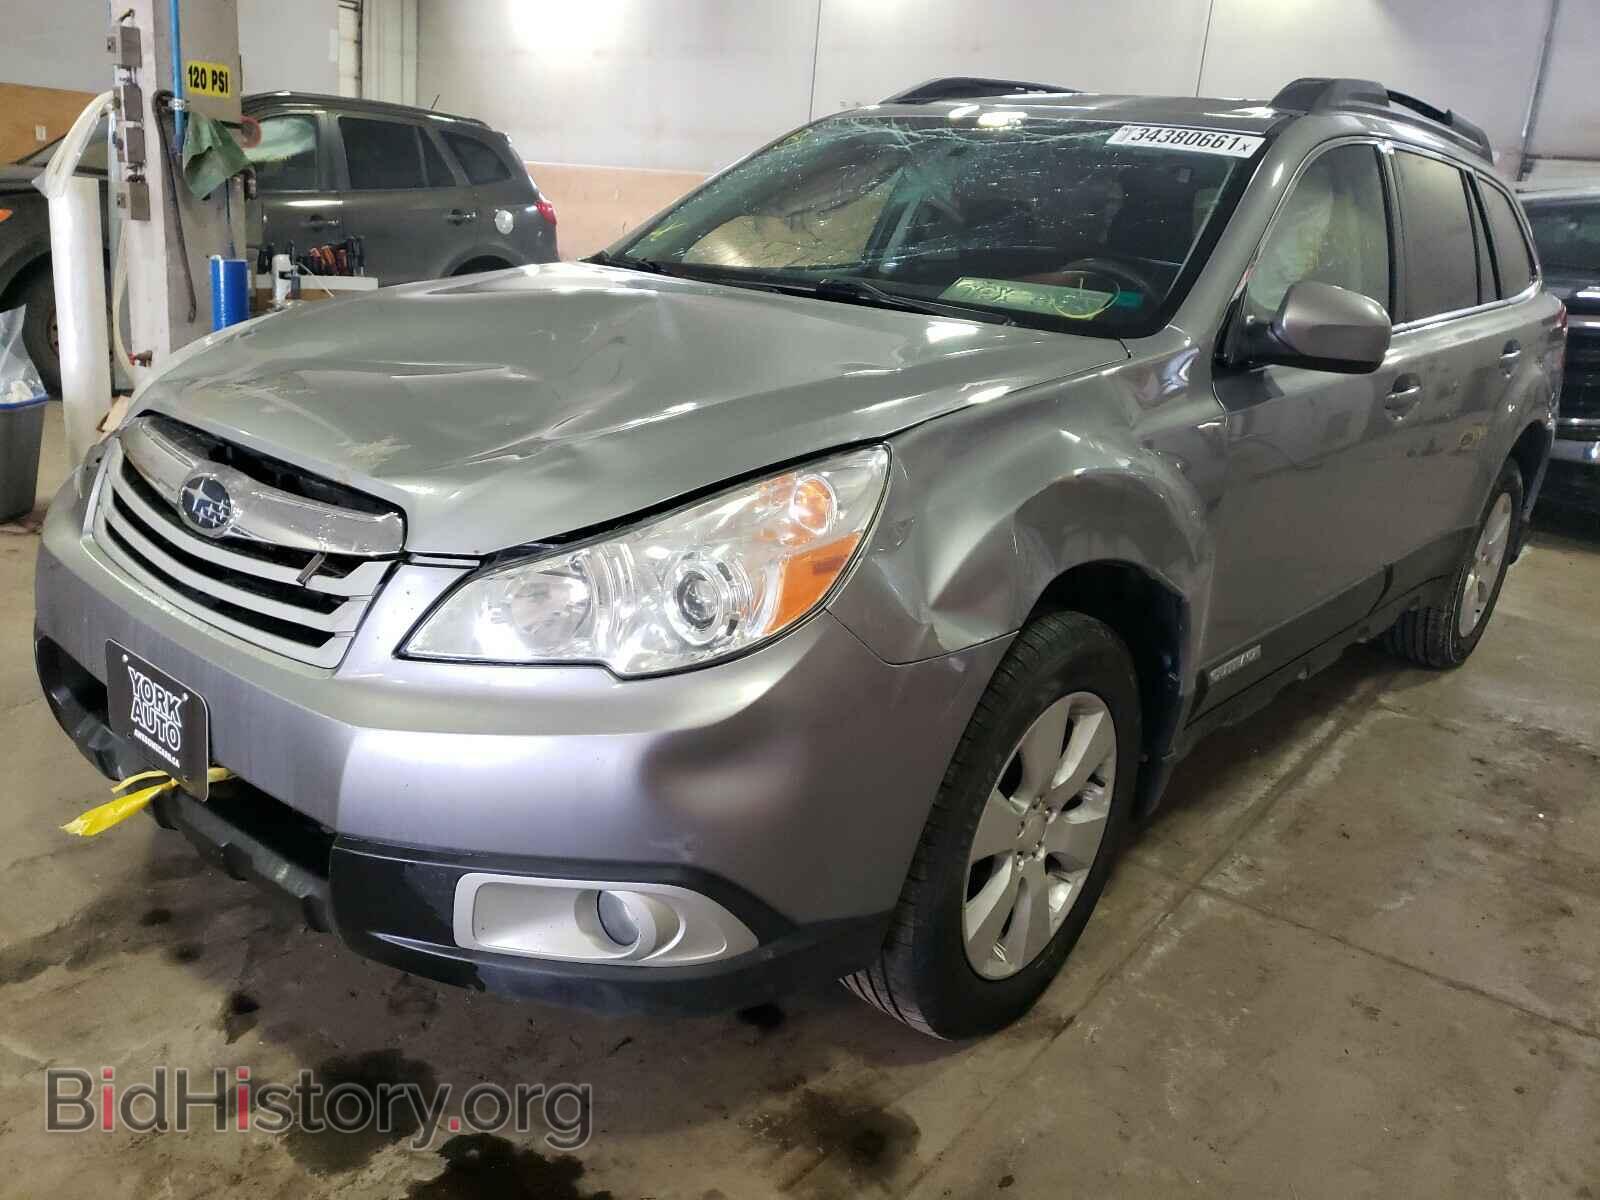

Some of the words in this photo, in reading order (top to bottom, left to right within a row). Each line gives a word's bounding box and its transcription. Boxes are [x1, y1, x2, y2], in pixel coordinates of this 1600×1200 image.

[188, 64, 207, 90] 120
[211, 69, 228, 94] PSI
[1131, 127, 1241, 151] 34380661
[128, 666, 182, 728] YORK
[131, 697, 181, 751] AUTO
